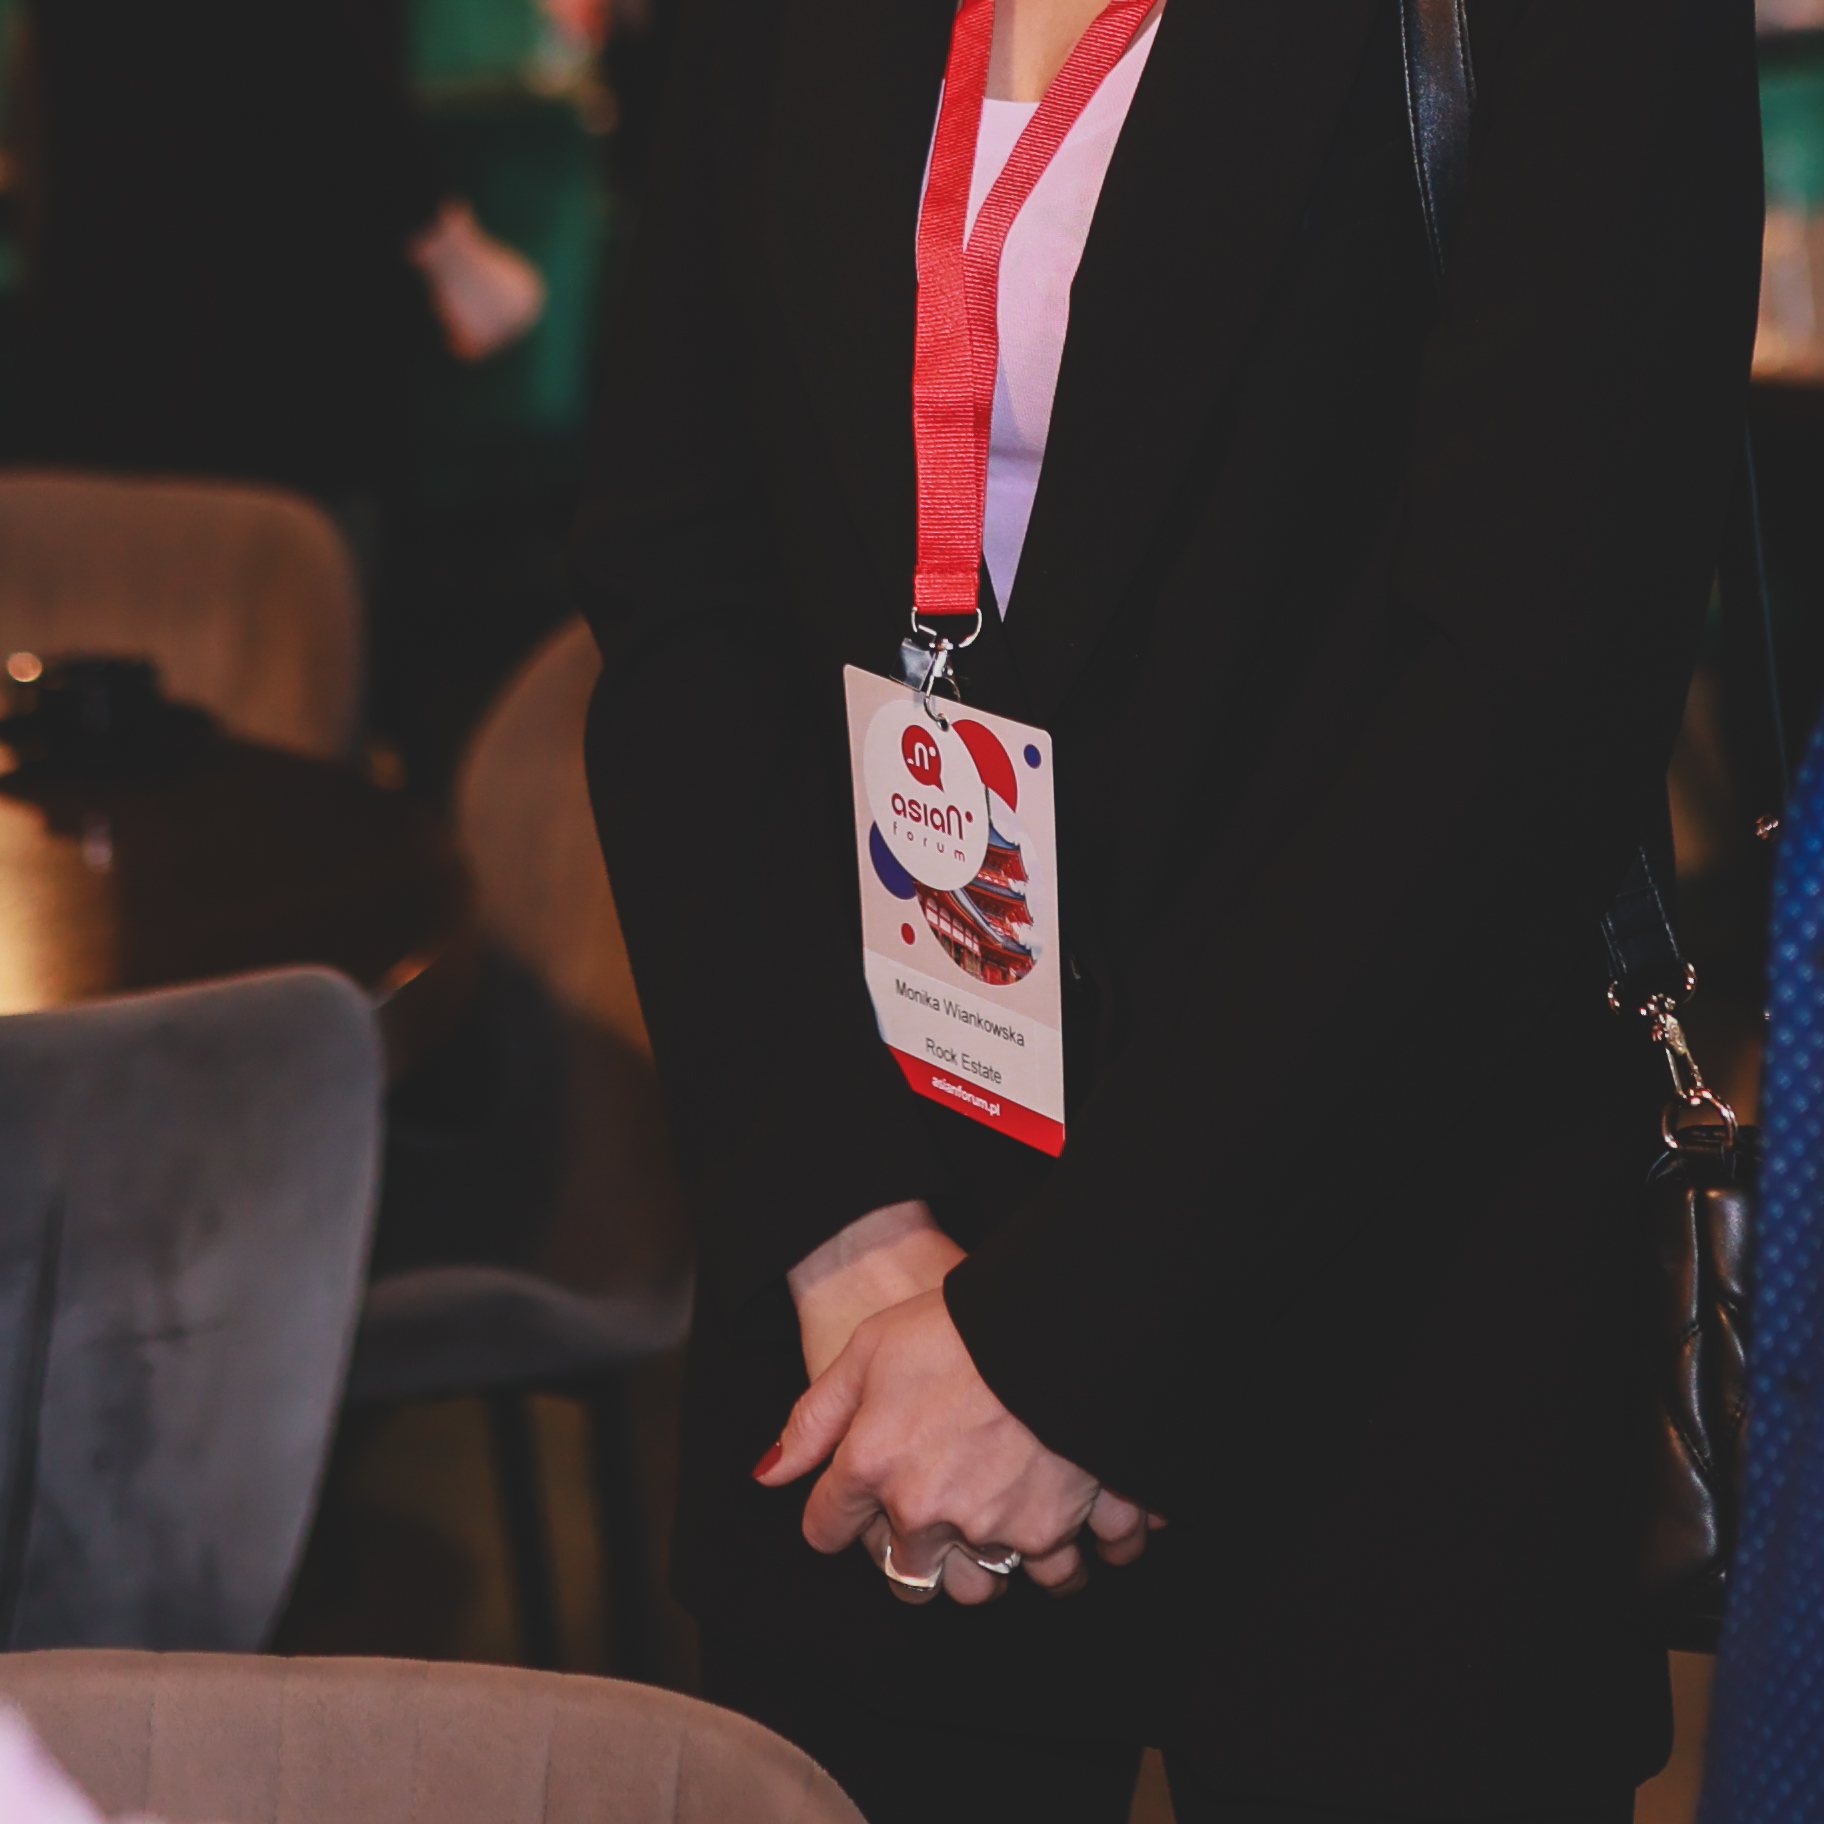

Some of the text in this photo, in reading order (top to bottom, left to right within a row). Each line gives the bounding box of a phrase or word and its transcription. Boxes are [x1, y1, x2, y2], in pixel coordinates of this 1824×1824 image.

[893, 821, 966, 862] forum
[895, 978, 1025, 1047] Monika Wiankowska
[925, 1037, 1002, 1085] Rock Estate
[931, 1076, 1001, 1116] asianforum.pl
